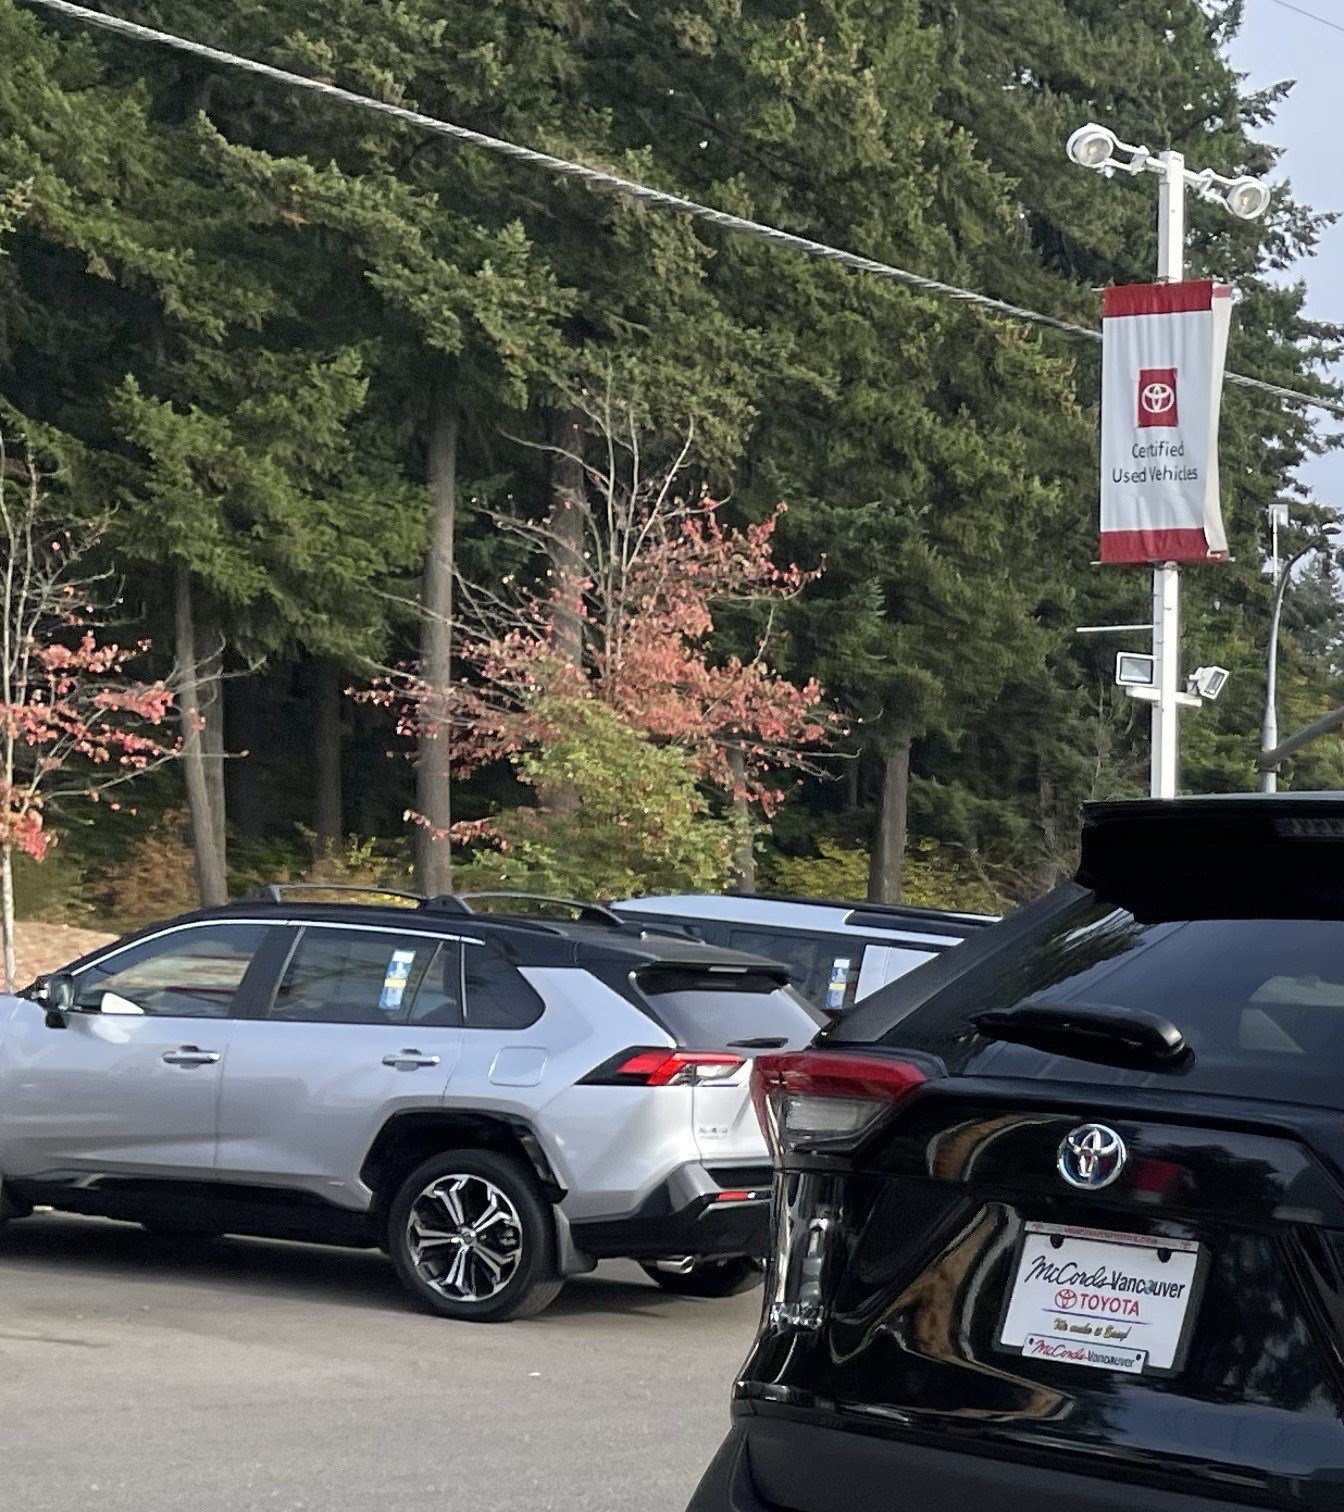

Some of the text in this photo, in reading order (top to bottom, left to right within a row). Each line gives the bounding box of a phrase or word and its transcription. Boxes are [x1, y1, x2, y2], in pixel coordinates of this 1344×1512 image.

[1131, 440, 1185, 459] Certified
[1112, 465, 1198, 484] Used Vehicles
[1080, 1293, 1140, 1316] TOYOTA
